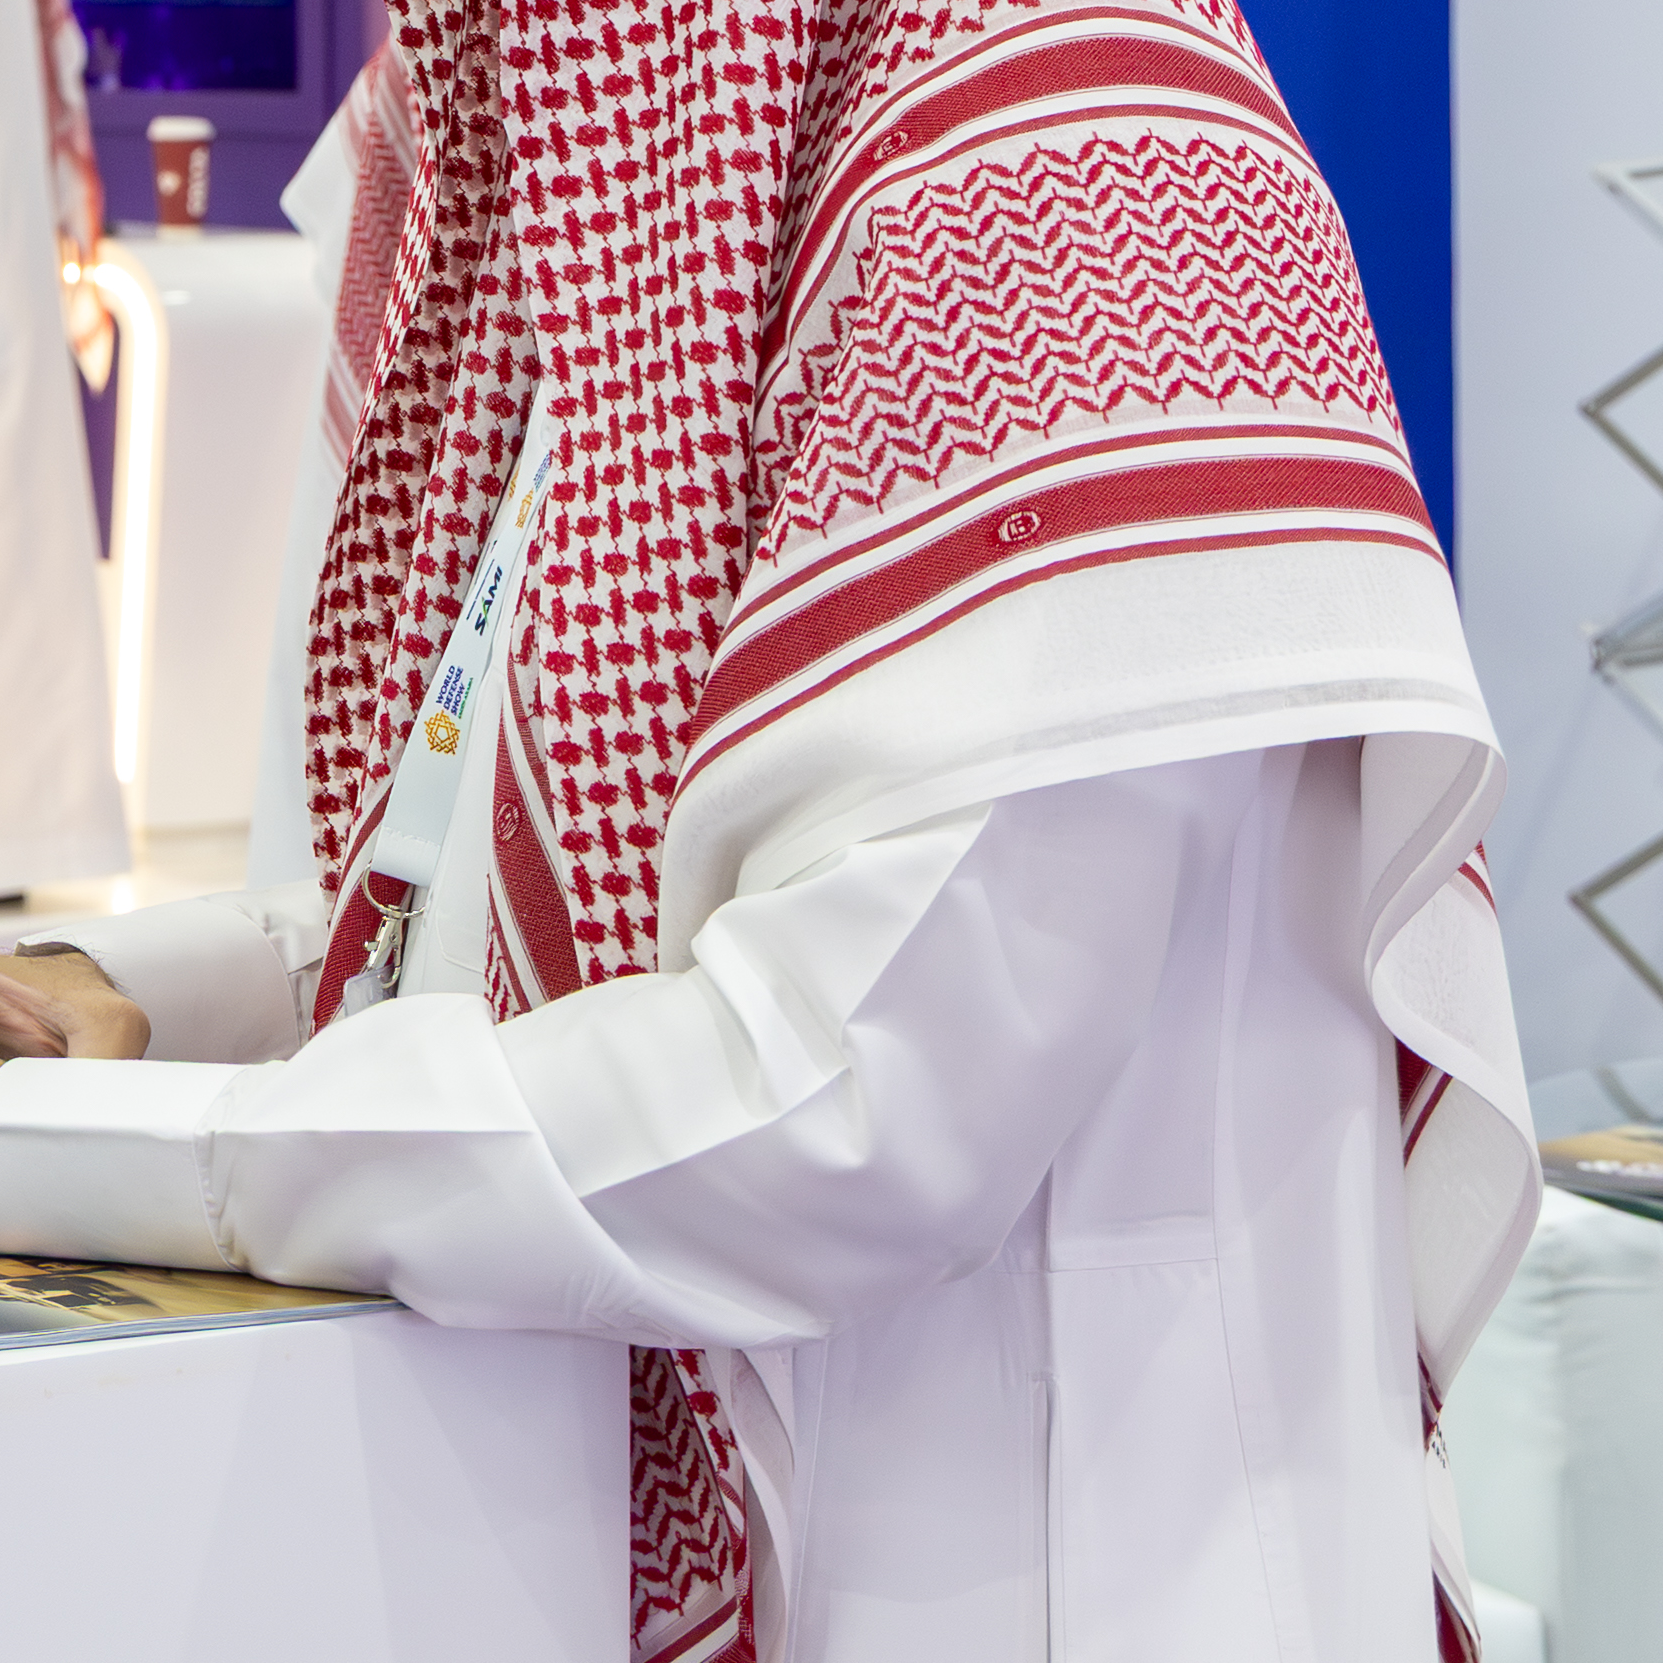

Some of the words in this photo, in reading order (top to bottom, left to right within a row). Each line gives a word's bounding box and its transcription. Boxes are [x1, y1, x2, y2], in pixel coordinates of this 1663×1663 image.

[474, 565, 503, 637] SAMI
[435, 664, 455, 704] WORLD
[443, 665, 464, 710] DEFENSE
[450, 682, 466, 716] SHOW
